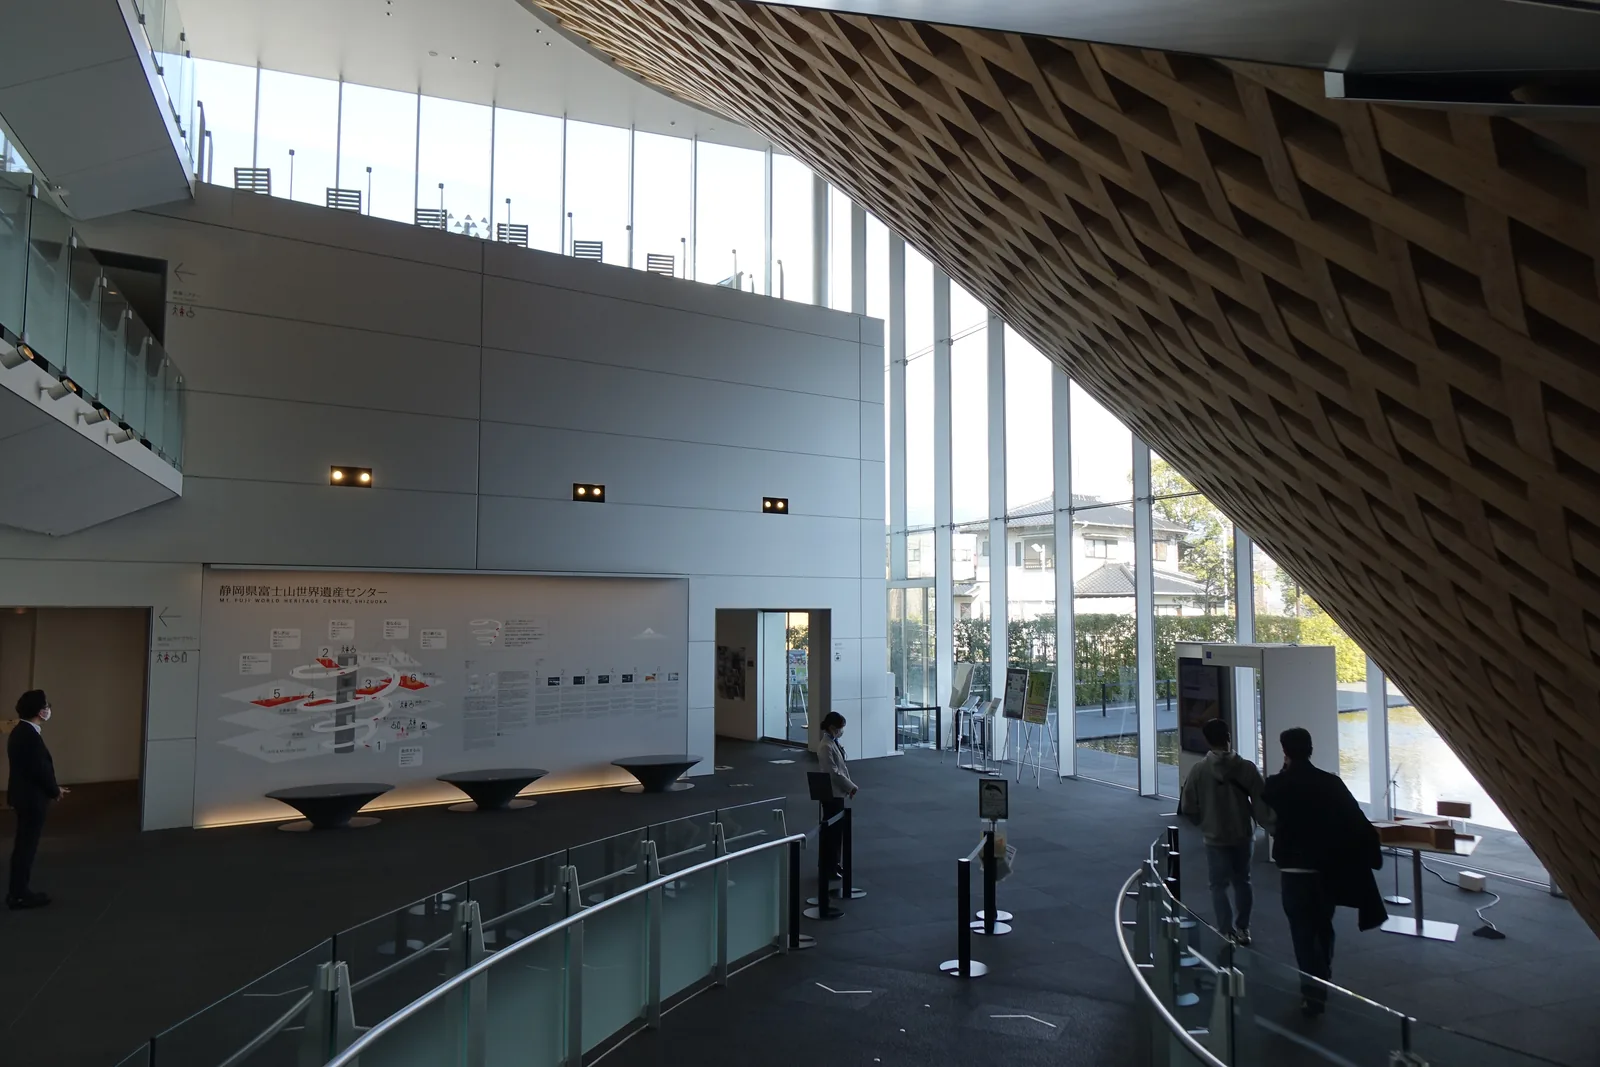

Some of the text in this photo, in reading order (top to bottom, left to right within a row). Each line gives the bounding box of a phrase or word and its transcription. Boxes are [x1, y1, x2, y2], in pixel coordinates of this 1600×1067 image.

[219, 585, 388, 598] 静岡県富士山世界遺産センター
[321, 647, 329, 658] 2
[410, 673, 417, 682] 6
[365, 679, 372, 689] 3
[273, 688, 281, 699] 5
[307, 690, 316, 700] 4
[376, 741, 381, 751] 1
